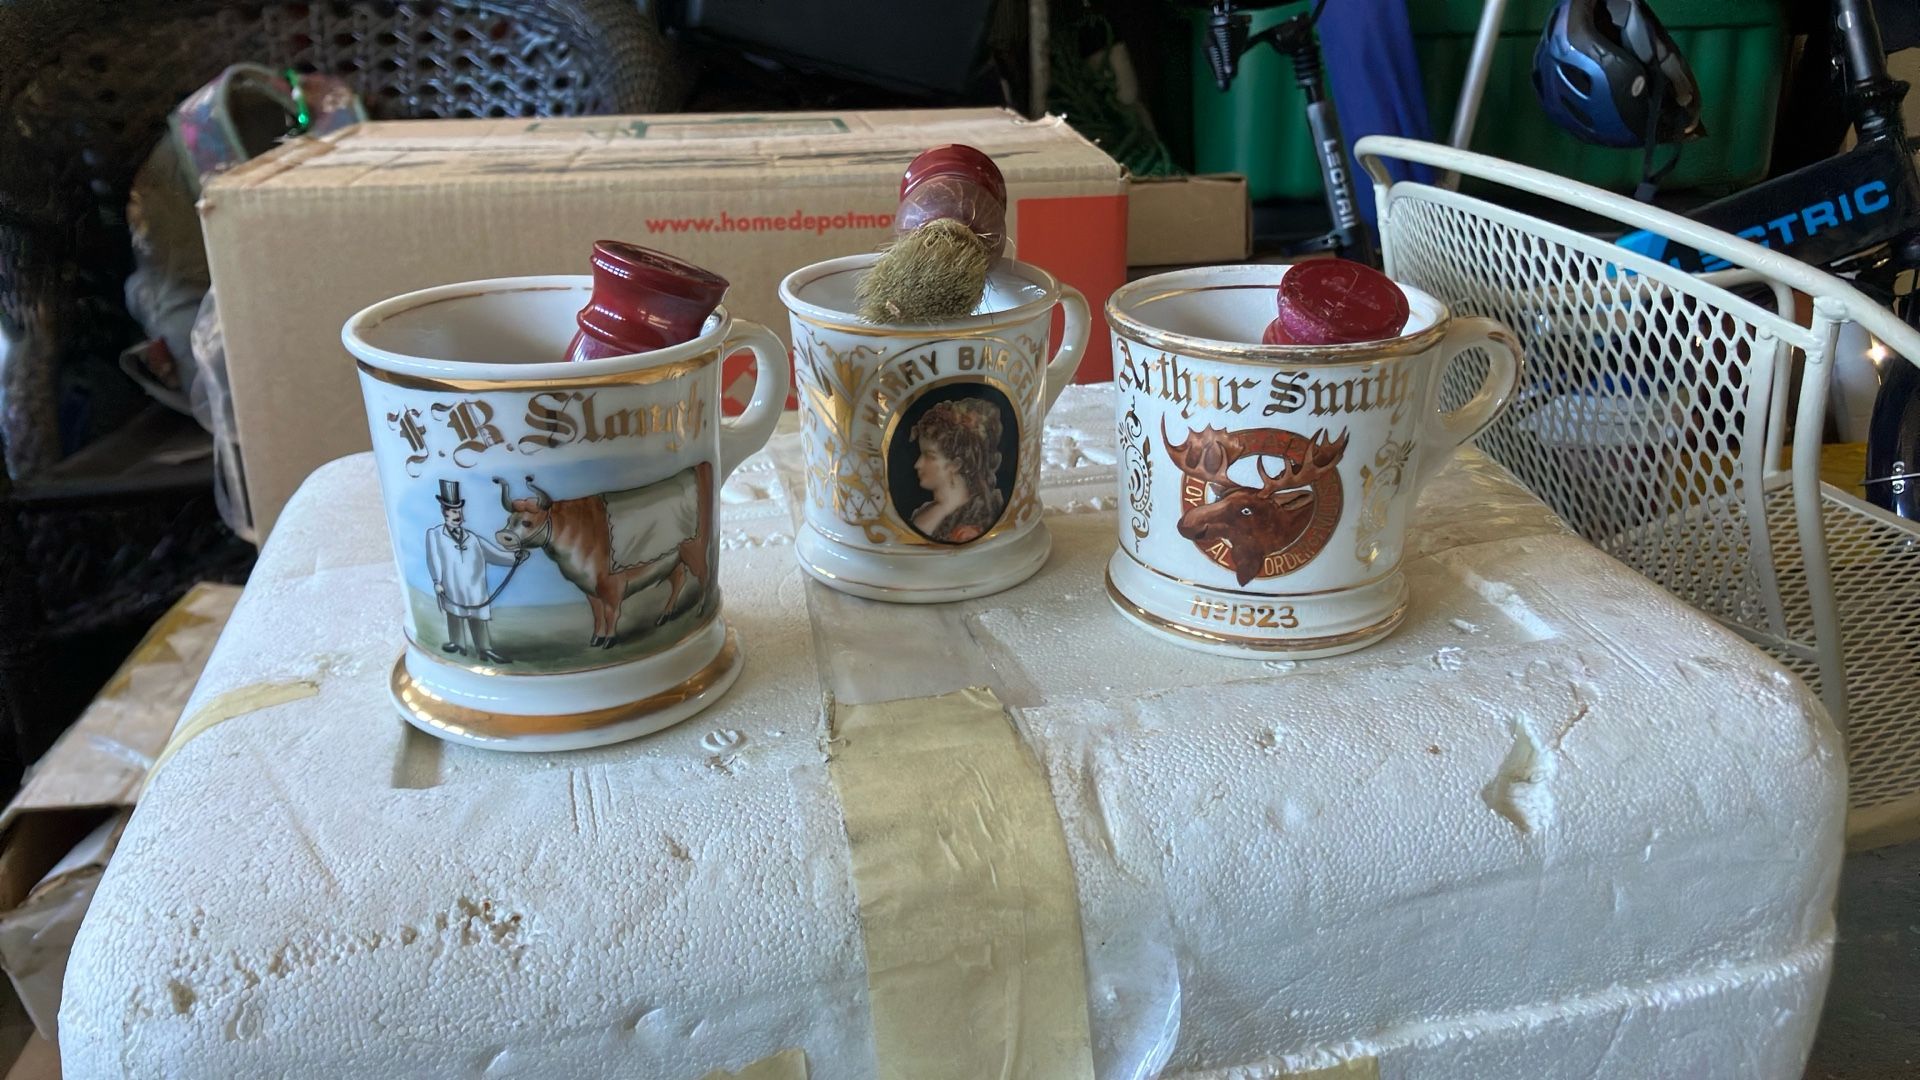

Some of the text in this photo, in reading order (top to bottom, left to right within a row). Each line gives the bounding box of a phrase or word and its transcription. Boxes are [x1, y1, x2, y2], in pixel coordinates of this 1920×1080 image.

[862, 350, 939, 429] HARRY
[1117, 337, 1410, 425] Arthur Smith
